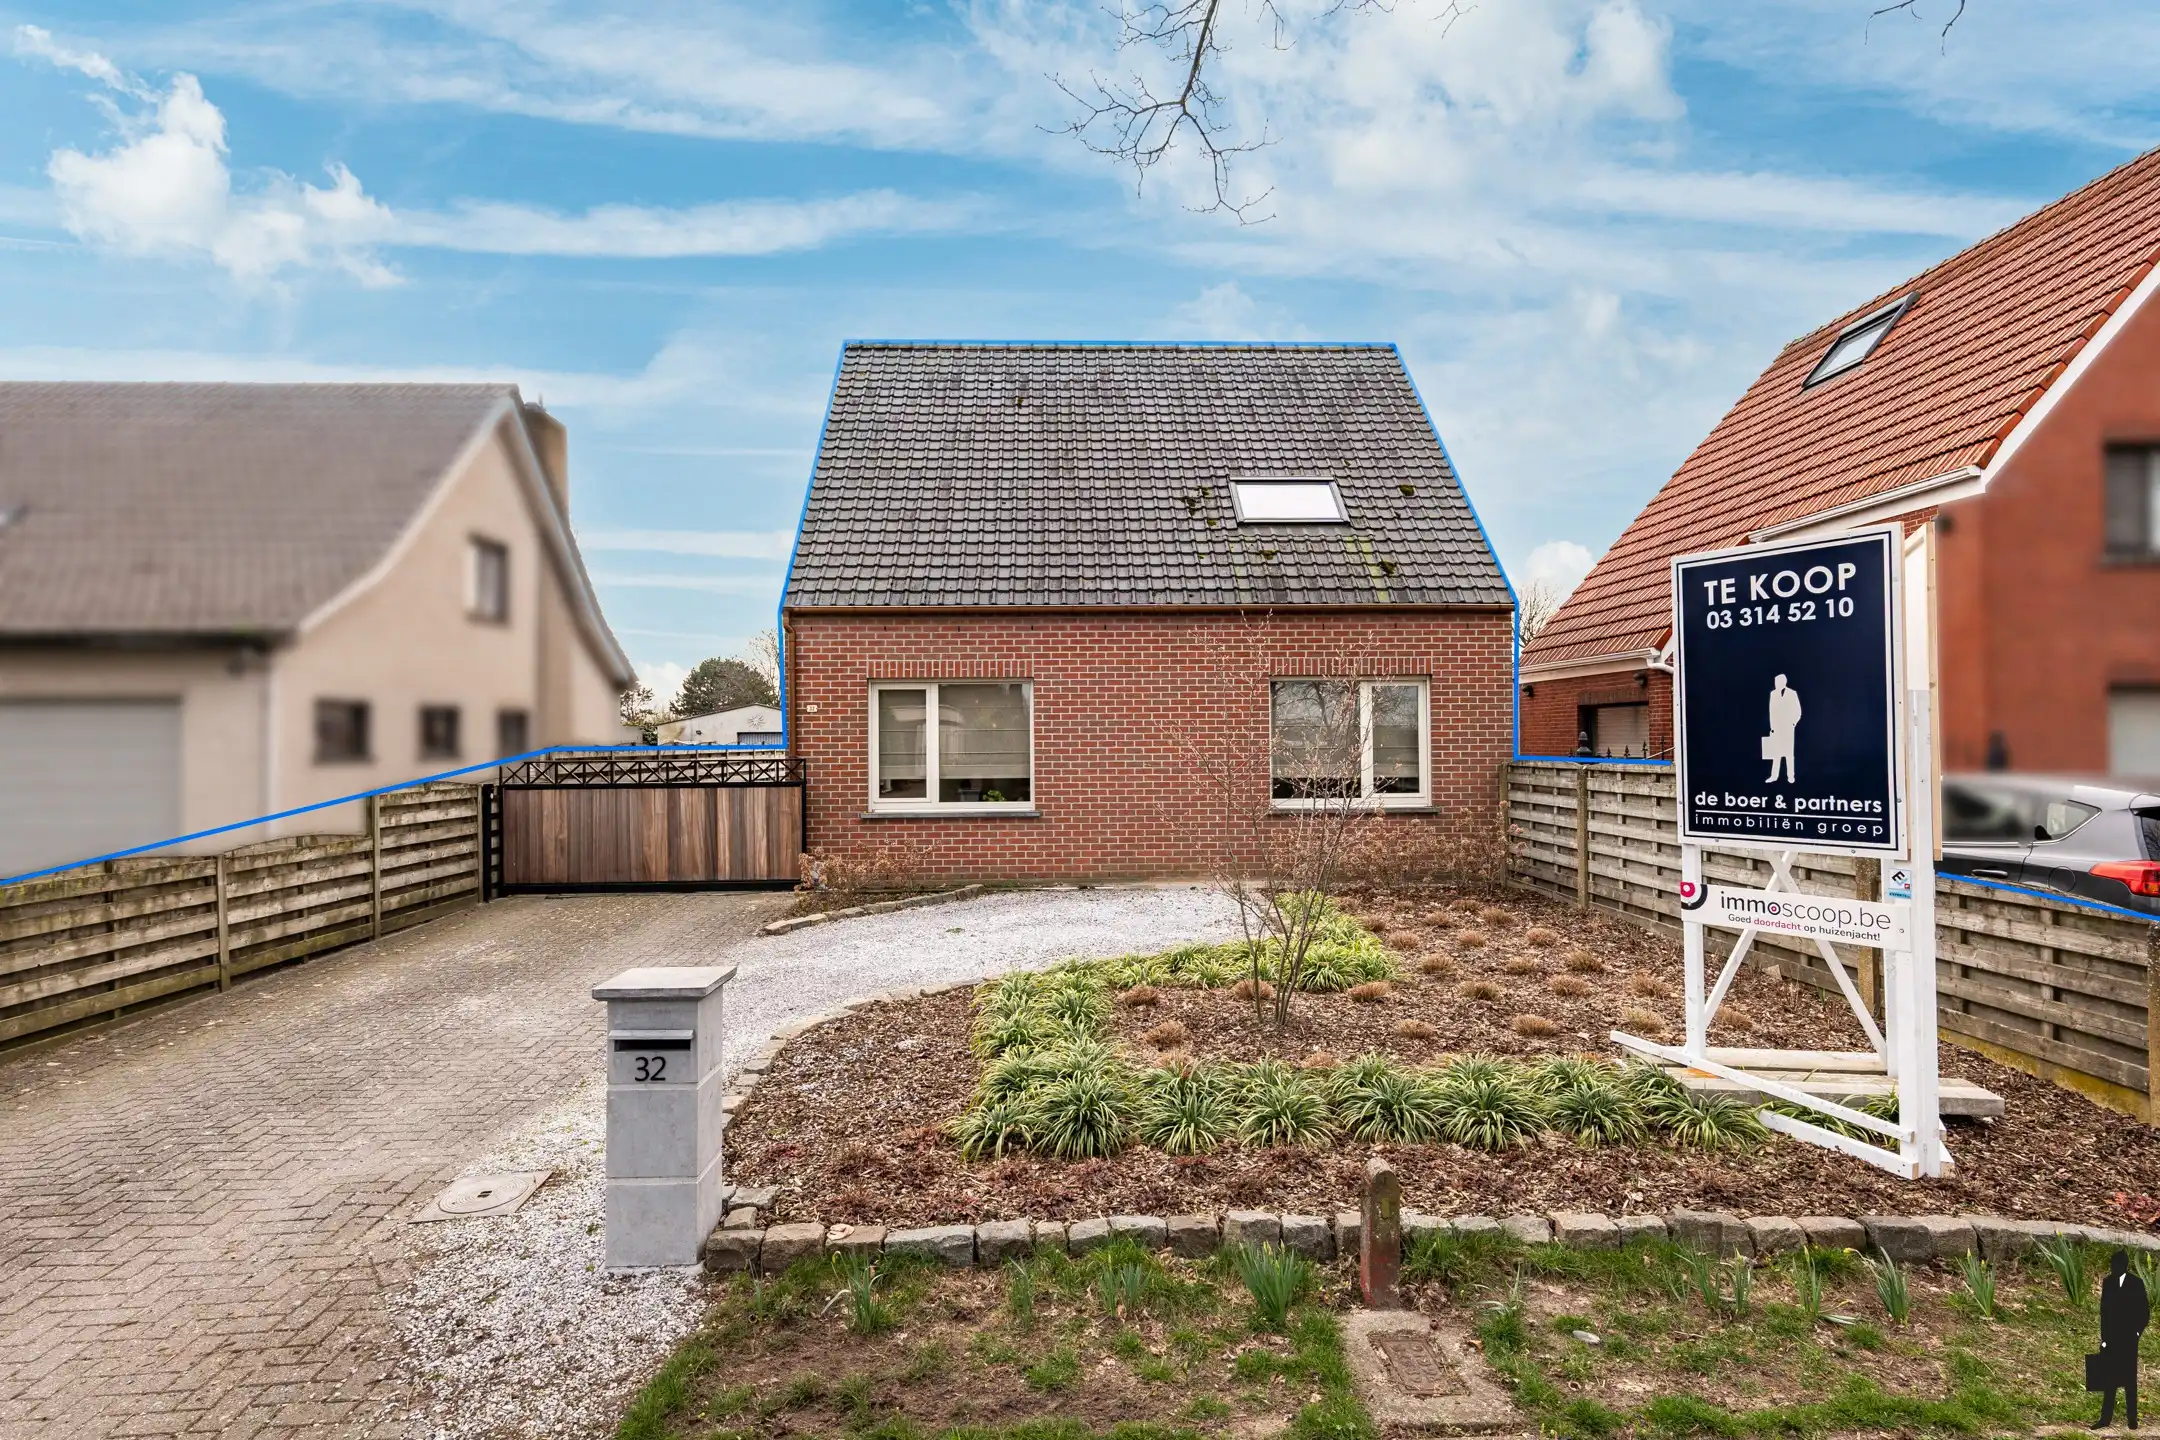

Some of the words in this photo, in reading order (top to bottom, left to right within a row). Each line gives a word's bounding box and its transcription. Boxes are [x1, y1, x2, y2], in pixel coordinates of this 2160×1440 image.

[1703, 577, 1736, 606] TE
[1750, 562, 1857, 601] KOOP
[1706, 609, 1733, 630] 03
[1739, 604, 1781, 627] 314
[1787, 600, 1816, 622] 52
[1825, 596, 1855, 619] 10
[1695, 791, 1718, 806] de
[1724, 792, 1768, 808] boer
[1774, 794, 1787, 809] &
[1794, 795, 1882, 813] partners
[1695, 813, 1804, 831] immobiliën
[1817, 822, 1883, 837] groep
[1720, 891, 1891, 930] immoscoop.be
[1728, 913, 1752, 924] Goed
[1753, 918, 1801, 931] doordacht
[1803, 925, 1817, 934] op
[1818, 926, 1881, 941] huizenjacht!
[634, 1056, 667, 1082] 32
